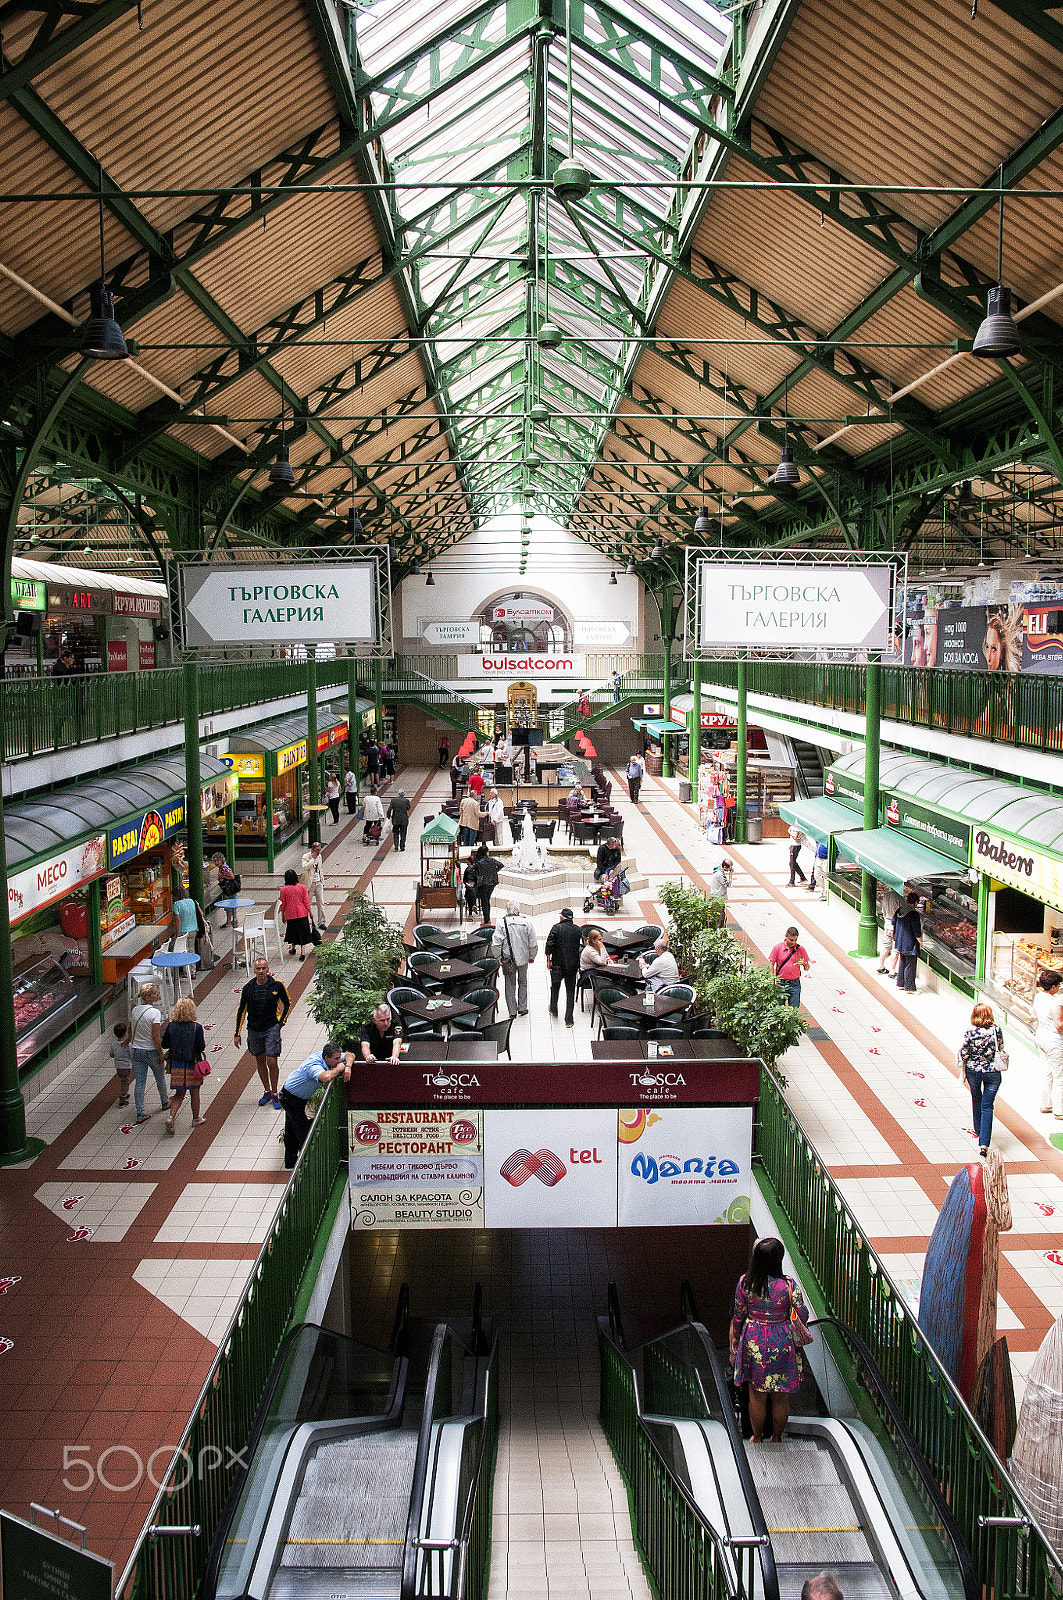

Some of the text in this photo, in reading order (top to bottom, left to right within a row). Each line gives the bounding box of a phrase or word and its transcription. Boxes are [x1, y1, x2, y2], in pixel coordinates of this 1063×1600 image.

[15, 582, 37, 598] WEAR
[227, 584, 340, 601] ТЪРГОВСКА
[727, 584, 841, 602] ТЪРГОВСКА
[72, 592, 92, 608] ART
[114, 596, 160, 613] КРУМ МУШЕВ
[243, 606, 324, 624] ГАЛЕРИЯ
[745, 611, 827, 628] ГАЛЕРИЯ
[955, 621, 967, 633] 1000
[1028, 613, 1048, 635] ELI
[482, 657, 573, 670] bulsatcom
[943, 652, 979, 664] БОЯ ЗА КОСА
[165, 806, 184, 829] PASTA!
[112, 829, 138, 857] PASTA!
[976, 831, 1034, 876] Bakers
[423, 1073, 481, 1086] TOSCA
[629, 1073, 687, 1086] TOSCA
[646, 1086, 670, 1094] cafe
[376, 1111, 454, 1124] RESTAURANT
[378, 1142, 454, 1154] РЕСТОРАНТ
[570, 1147, 603, 1164] tel
[435, 1163, 459, 1171] ДЪРВО
[631, 1152, 740, 1185] Mania
[360, 1193, 453, 1202] САЛОН ЗА КРАСОТА
[395, 1209, 473, 1218] BEAUTY STUDIO
